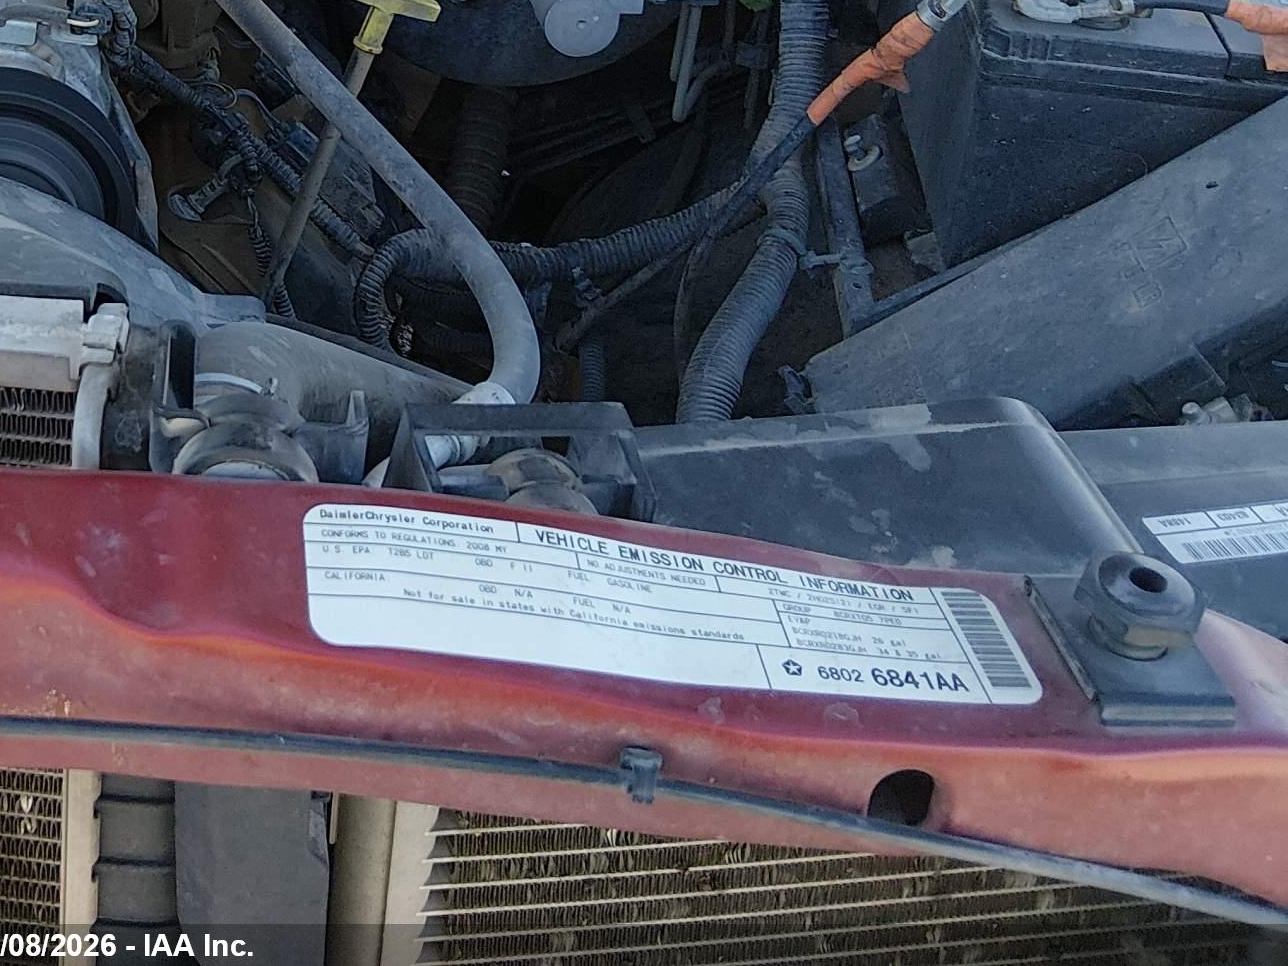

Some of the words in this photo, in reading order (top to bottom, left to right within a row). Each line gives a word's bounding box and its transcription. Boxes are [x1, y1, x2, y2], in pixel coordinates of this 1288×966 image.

[319, 509, 416, 524] DaimlerChrysler
[422, 513, 494, 533] Corporation
[321, 529, 369, 539] CONFORMS
[375, 531, 388, 539] TO
[466, 541, 490, 552] 2008
[495, 545, 508, 554] MY
[416, 550, 435, 560] LDT
[535, 529, 609, 555] VEHICLE
[618, 545, 704, 572] EMISSION
[713, 561, 788, 584] CONTROL
[800, 575, 914, 602] INFORMATION
[586, 559, 600, 569] NO
[604, 562, 666, 582] ADJUSTMENTS
[670, 573, 706, 587] NEEDED
[607, 577, 653, 593] GASOLINE
[513, 588, 534, 598] N/A
[403, 588, 422, 598] Not
[428, 590, 444, 600] for
[450, 593, 475, 605] sale
[482, 597, 494, 607] in
[499, 599, 535, 612] states
[540, 604, 565, 616] with
[569, 608, 628, 627] California
[632, 620, 685, 635] emissions
[690, 627, 745, 641] standards
[612, 603, 631, 615] N/A
[817, 665, 865, 683] 6802
[871, 667, 970, 692] 6841AA
